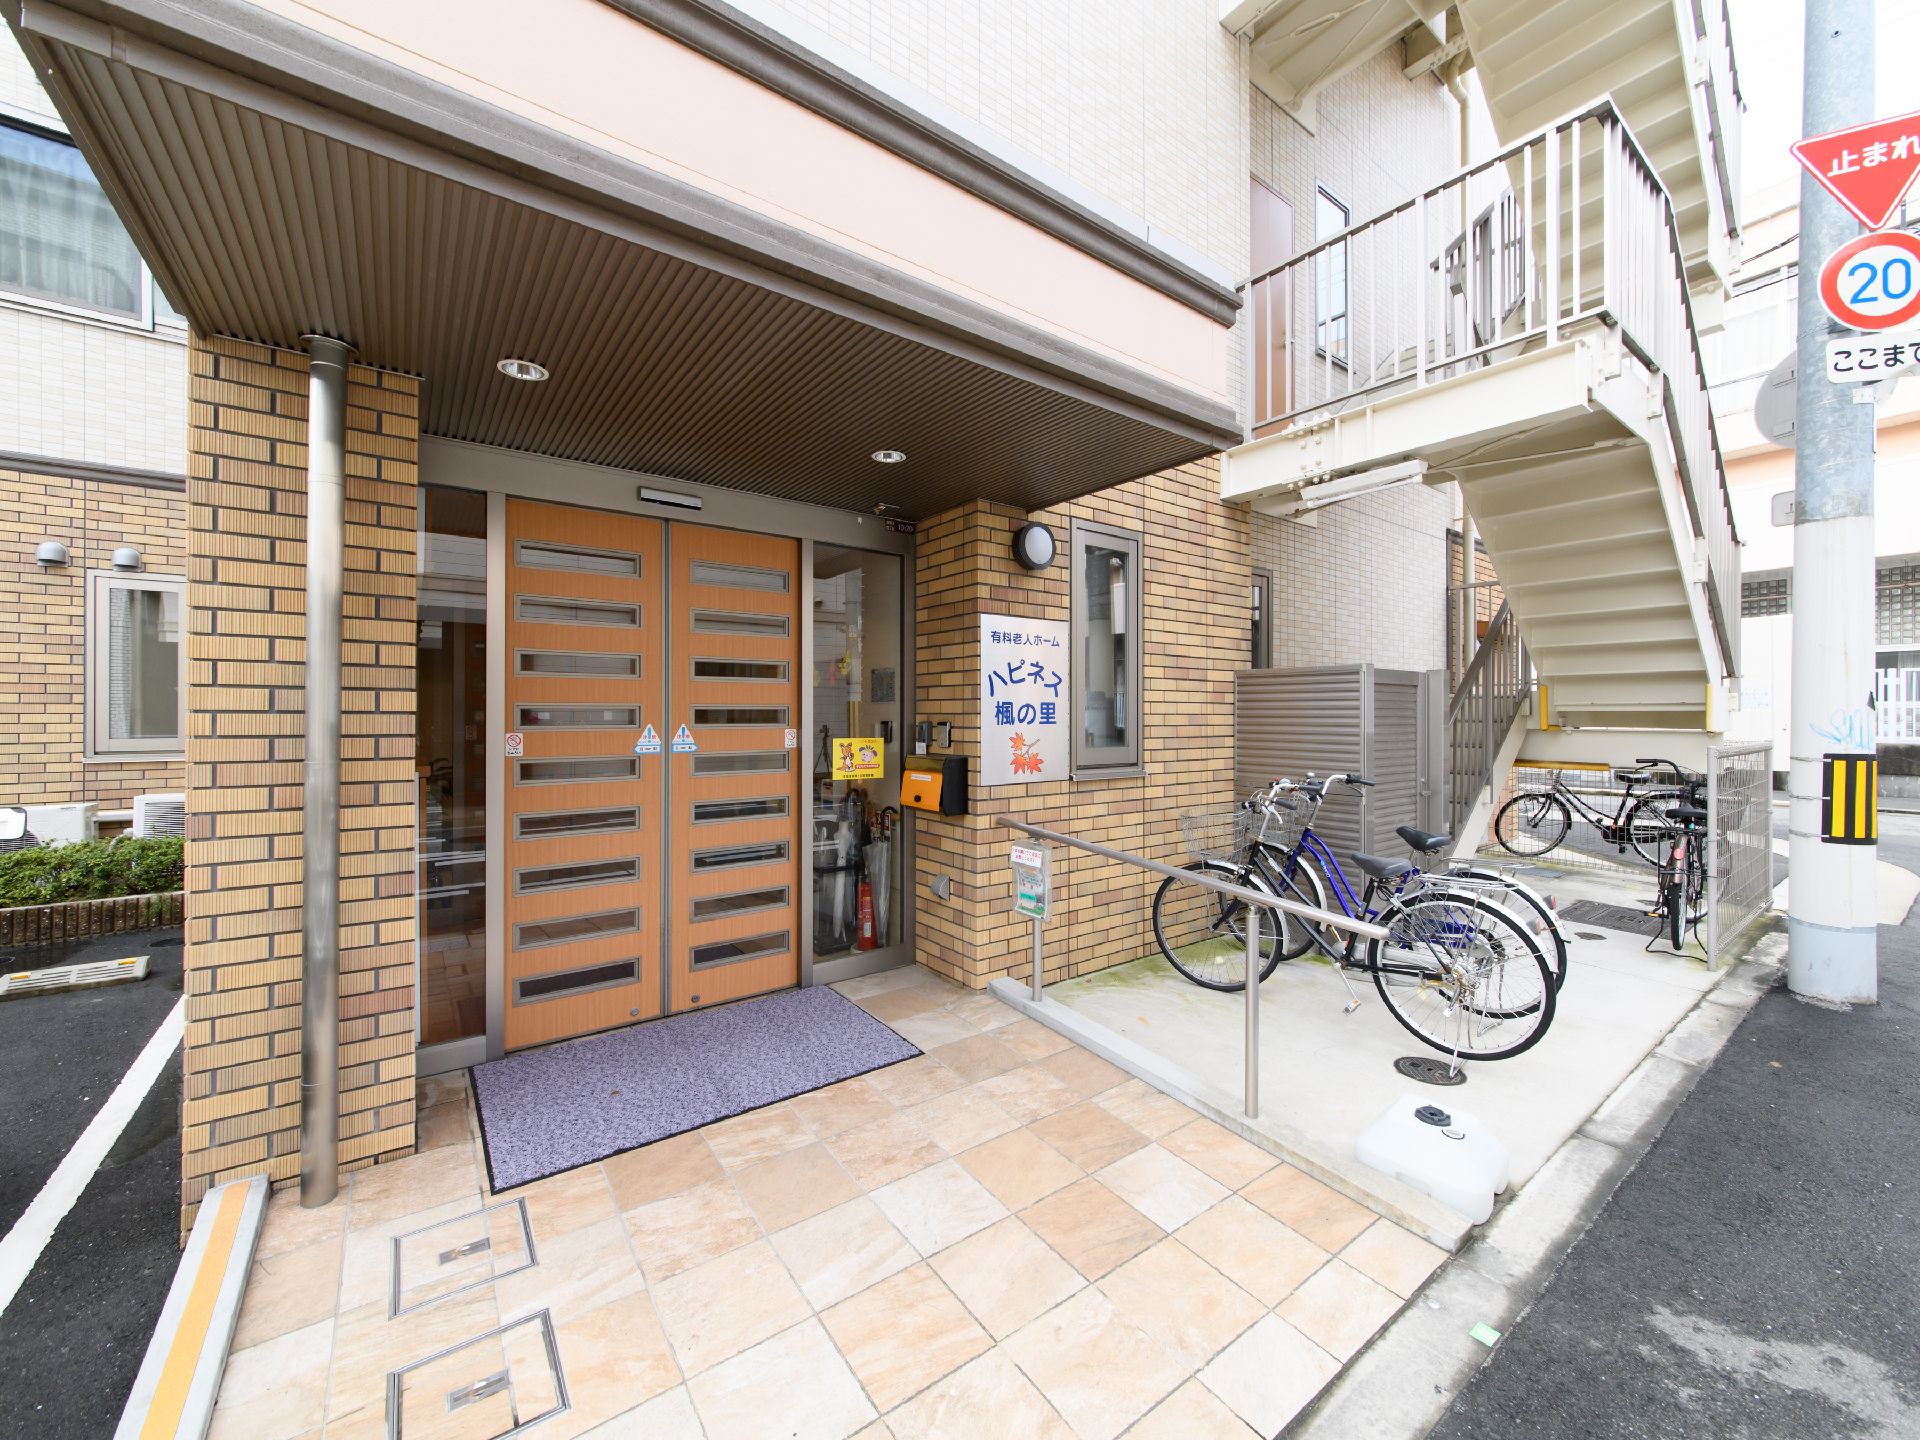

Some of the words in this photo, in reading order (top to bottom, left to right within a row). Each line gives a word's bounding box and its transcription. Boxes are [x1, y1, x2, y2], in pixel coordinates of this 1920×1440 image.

[1826, 134, 1920, 177] 止まれ
[1848, 258, 1912, 305] 20
[990, 630, 1060, 647] 有料老人ホーム
[987, 658, 1063, 698] ハピネス
[994, 700, 1057, 726] 楓の里
